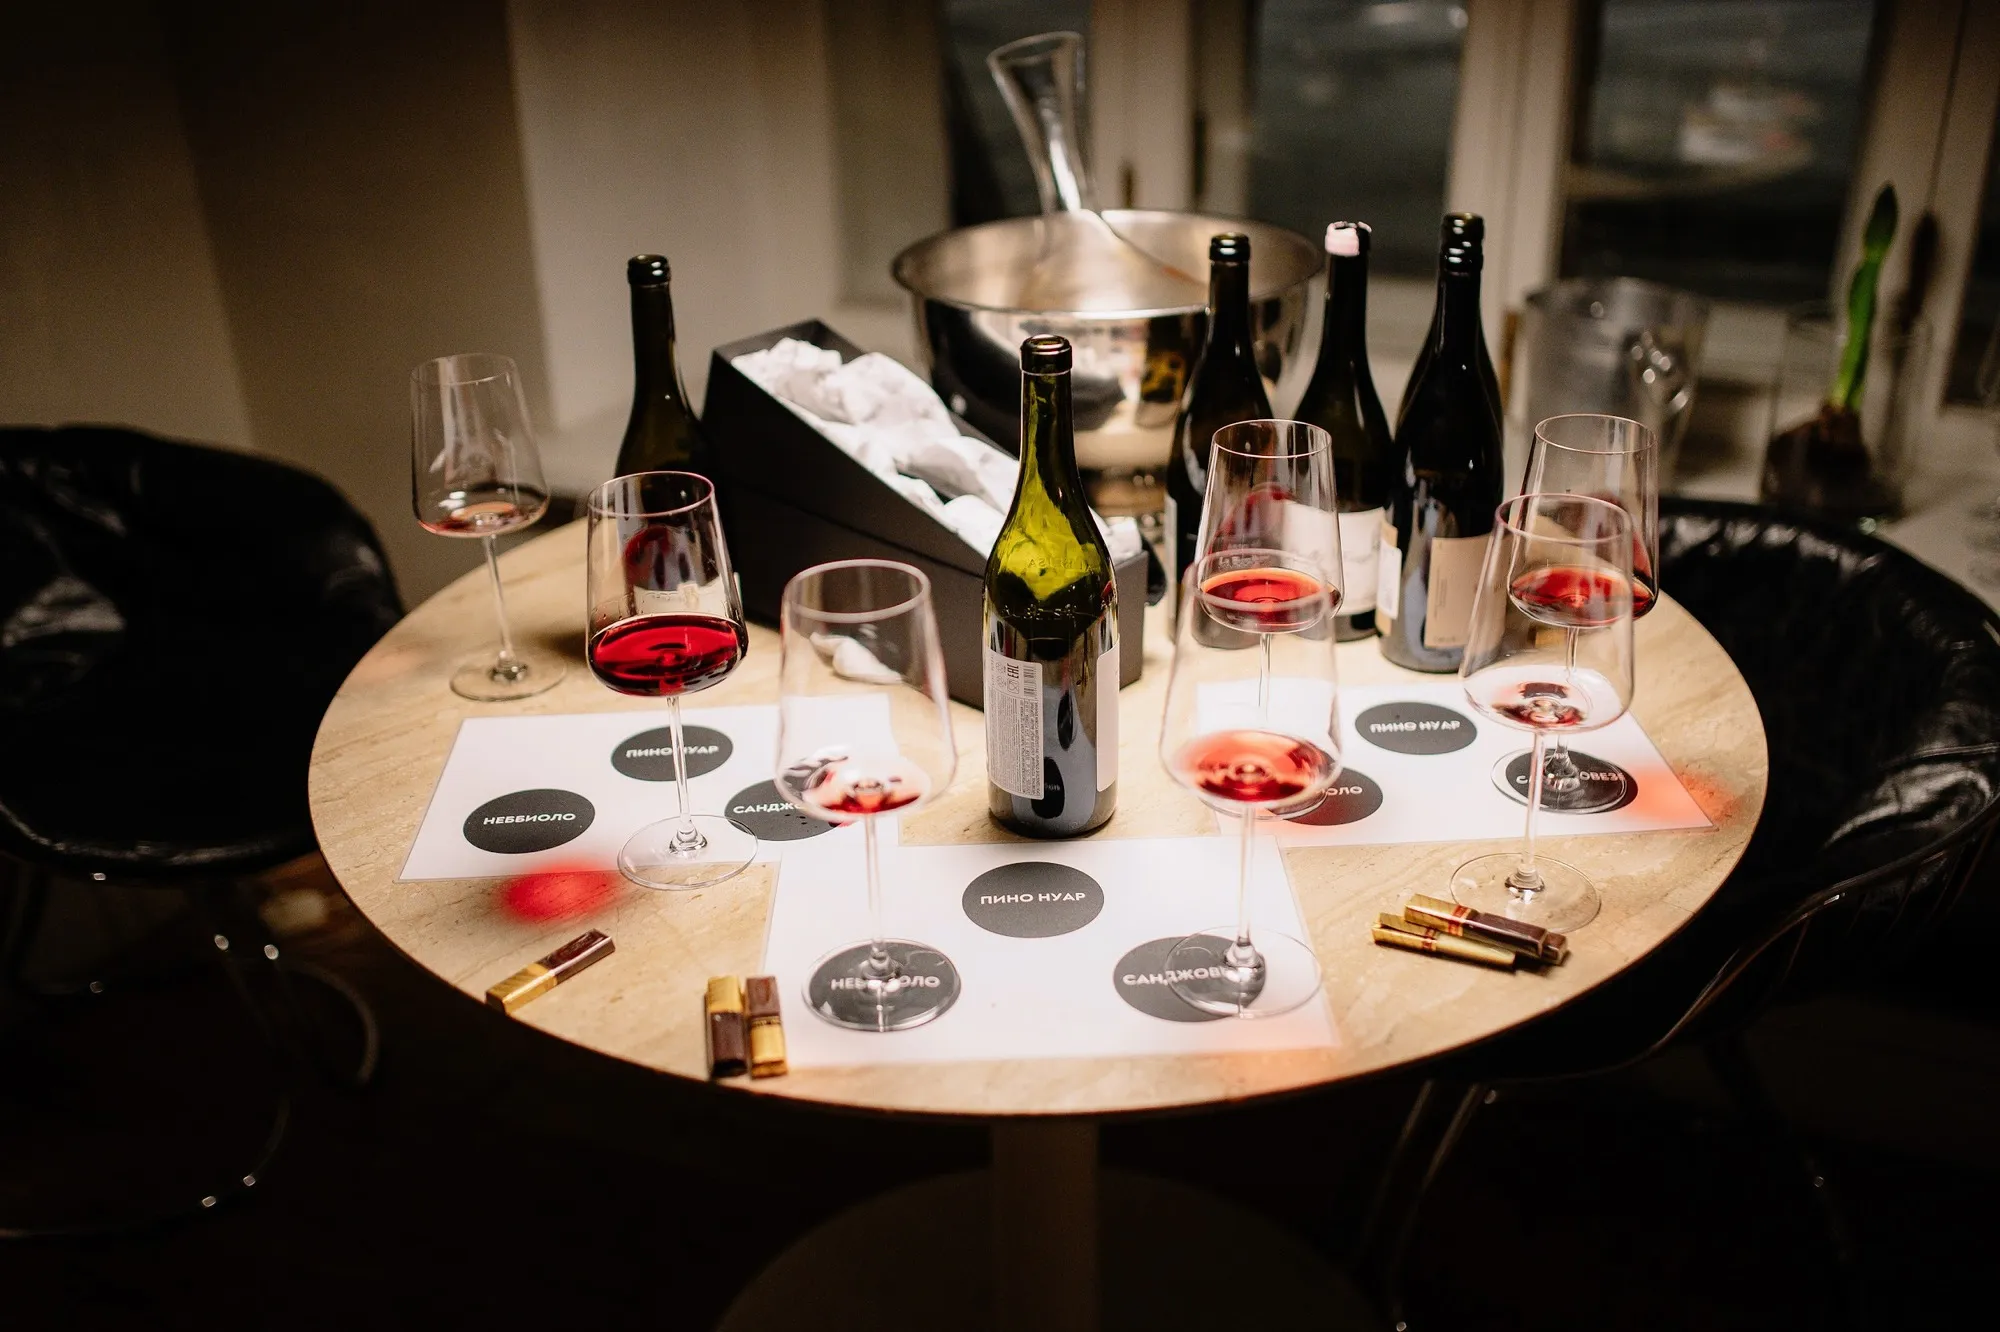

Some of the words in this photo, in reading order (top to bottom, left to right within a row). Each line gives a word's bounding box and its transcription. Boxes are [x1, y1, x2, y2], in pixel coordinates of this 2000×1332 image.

[1369, 721, 1418, 734] ПИНО
[1418, 720, 1461, 732] НУАР
[625, 747, 673, 758] ПИНО
[483, 813, 577, 825] НЕББИОЛО
[980, 893, 1034, 905] ПИНО
[1038, 892, 1086, 902] НУАР
[830, 974, 941, 991] НЕБОЛО
